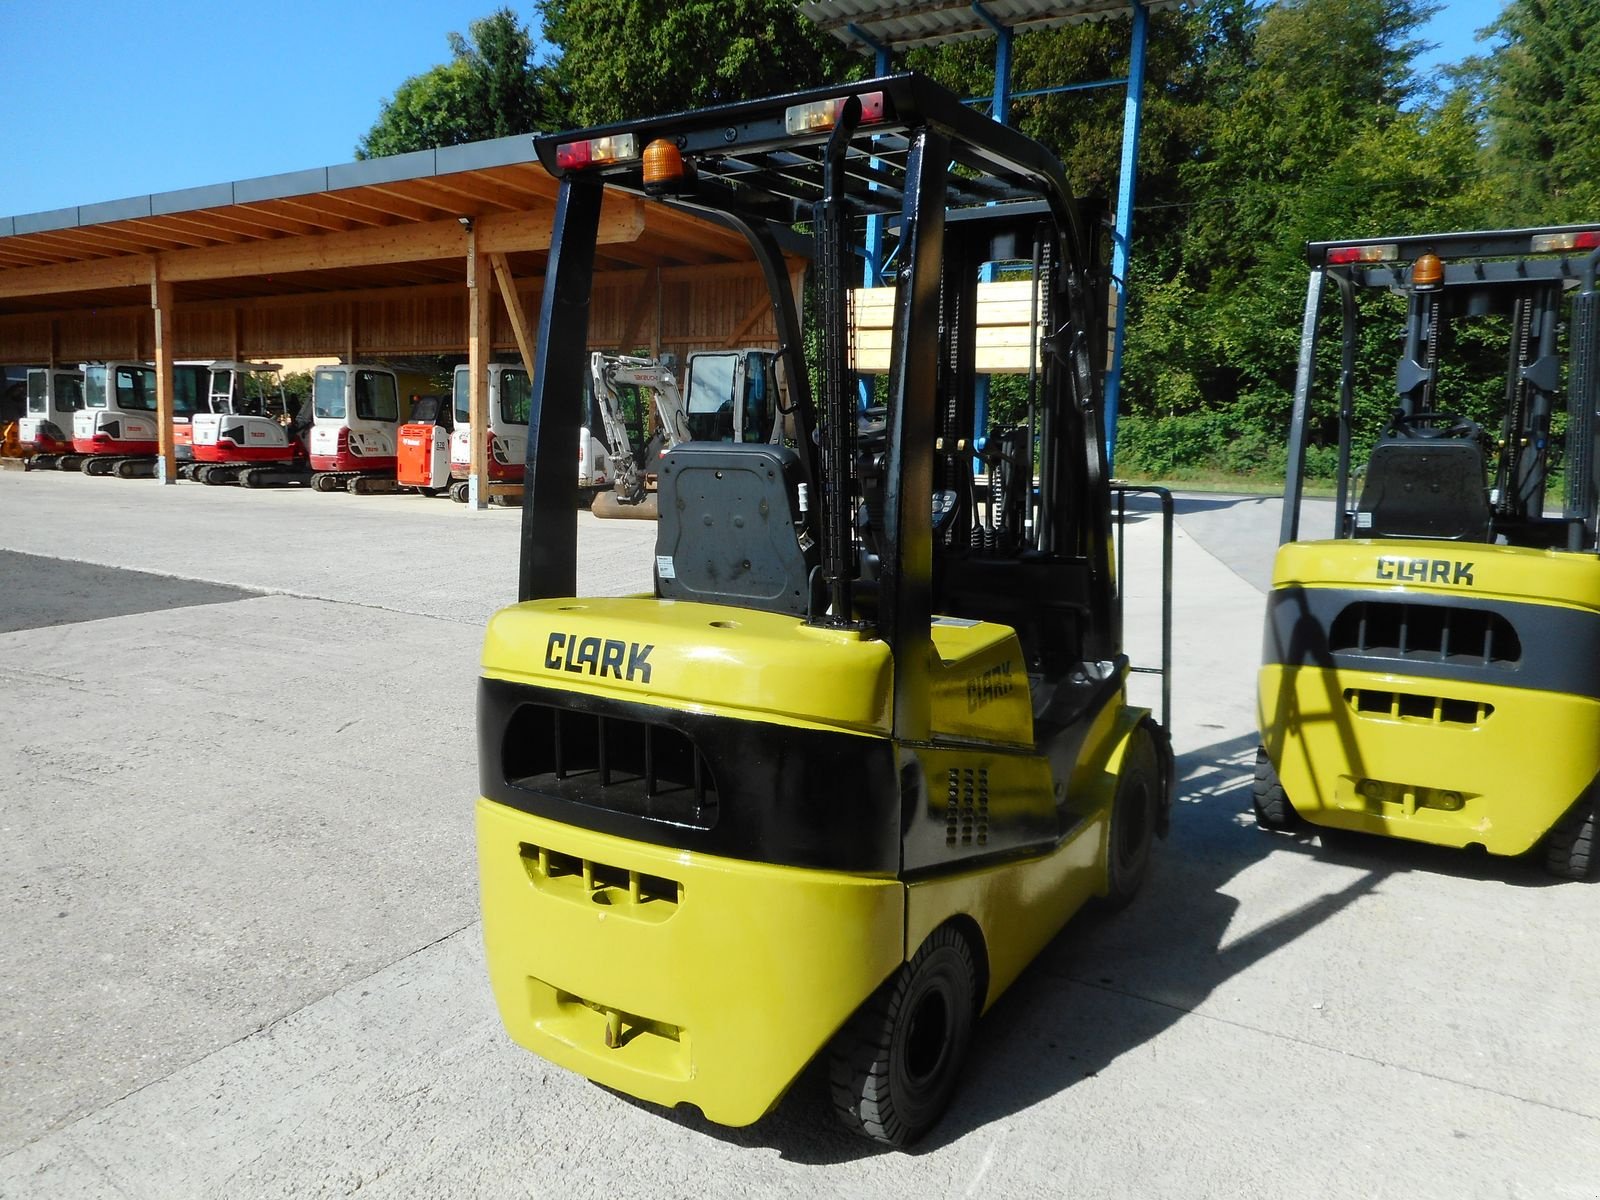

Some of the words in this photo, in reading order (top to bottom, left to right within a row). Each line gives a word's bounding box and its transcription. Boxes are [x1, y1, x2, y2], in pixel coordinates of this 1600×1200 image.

[1376, 558, 1475, 586] CLARK
[544, 632, 655, 684] CLARK
[967, 660, 1013, 714] CLARK
